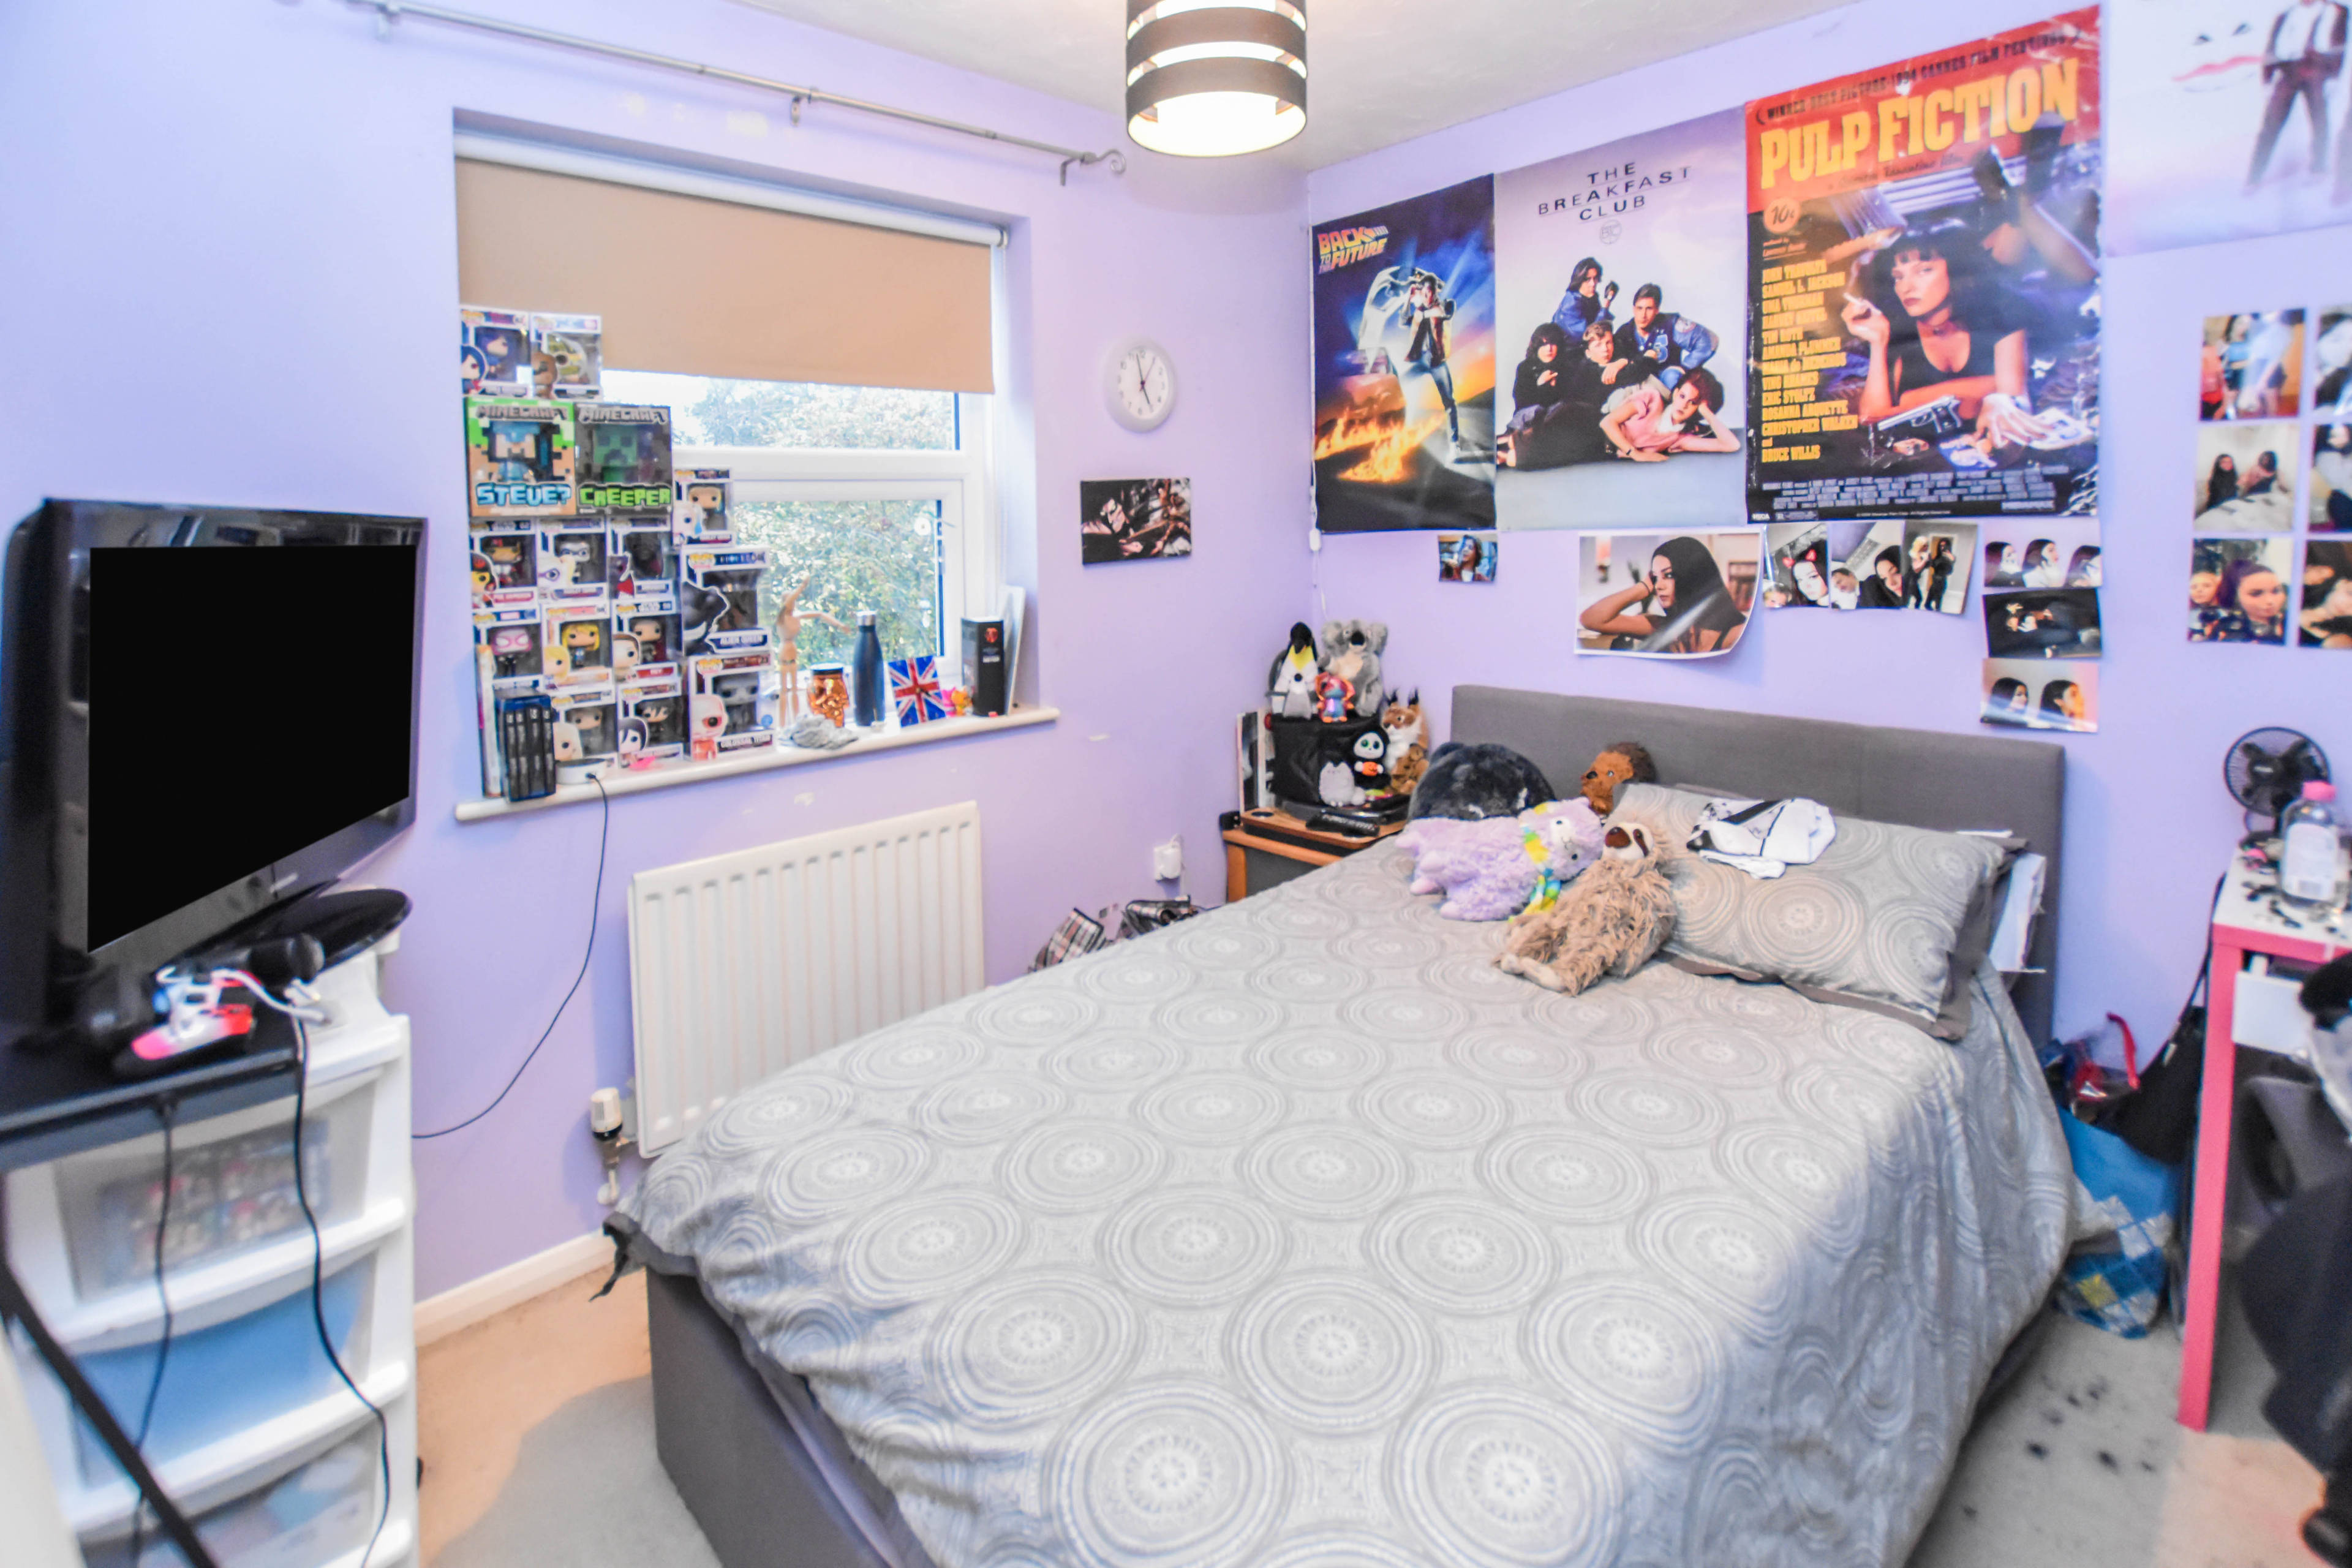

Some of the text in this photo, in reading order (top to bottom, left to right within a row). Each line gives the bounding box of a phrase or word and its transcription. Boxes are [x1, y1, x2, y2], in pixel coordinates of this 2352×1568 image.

[1760, 58, 2079, 190] PULP FICTION
[1587, 162, 1636, 184] THE
[1538, 166, 1691, 215] BREAKFAST
[1579, 195, 1645, 221] CLUB
[1318, 227, 1376, 255] BACK
[1320, 254, 1332, 265] TO
[1330, 238, 1388, 270] FUTURE
[478, 405, 568, 421] MINECRAFT
[579, 407, 668, 424] MINECRAFT
[477, 483, 571, 507] STEVE?
[579, 487, 671, 507] CREEPER
